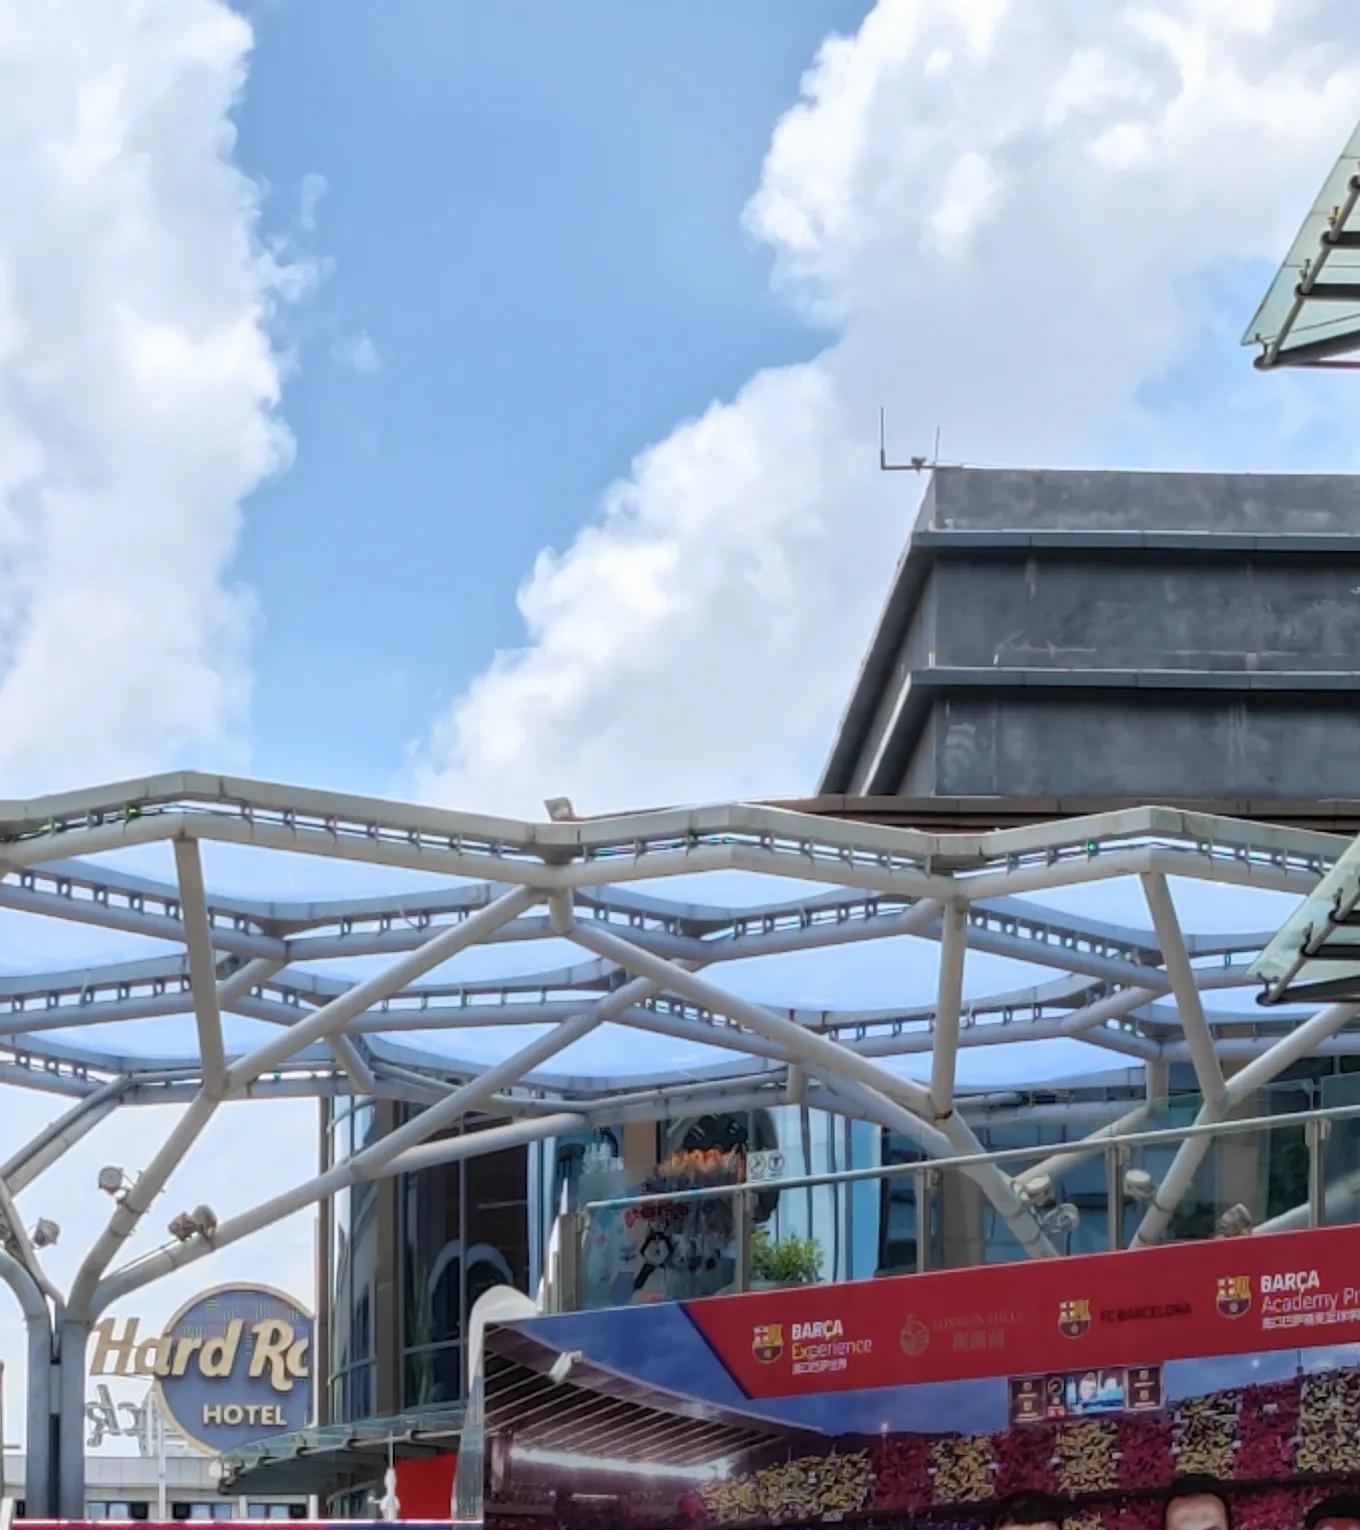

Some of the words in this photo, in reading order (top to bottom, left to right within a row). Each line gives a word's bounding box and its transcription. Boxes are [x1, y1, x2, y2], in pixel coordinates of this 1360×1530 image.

[1260, 1270, 1320, 1295] BARÇA
[791, 1319, 844, 1342] BARÇA
[90, 1317, 244, 1377] Hard
[202, 1404, 288, 1426] HOTEL
